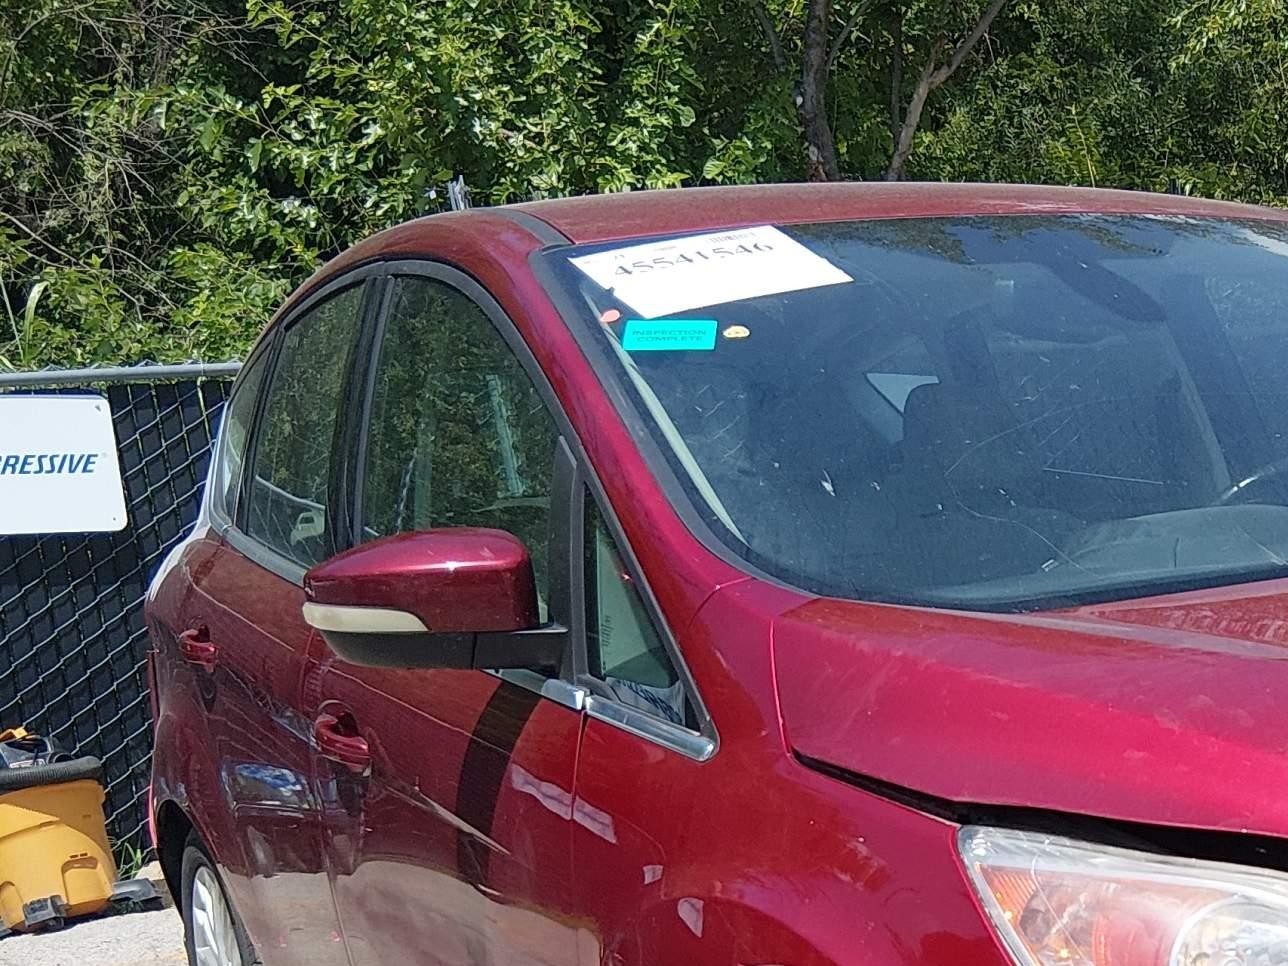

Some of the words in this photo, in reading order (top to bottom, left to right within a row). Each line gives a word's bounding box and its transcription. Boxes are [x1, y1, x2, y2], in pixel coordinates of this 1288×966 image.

[614, 242, 775, 277] 45541546
[631, 329, 708, 337] INSPECTION
[0, 453, 99, 475] RESSIVE
